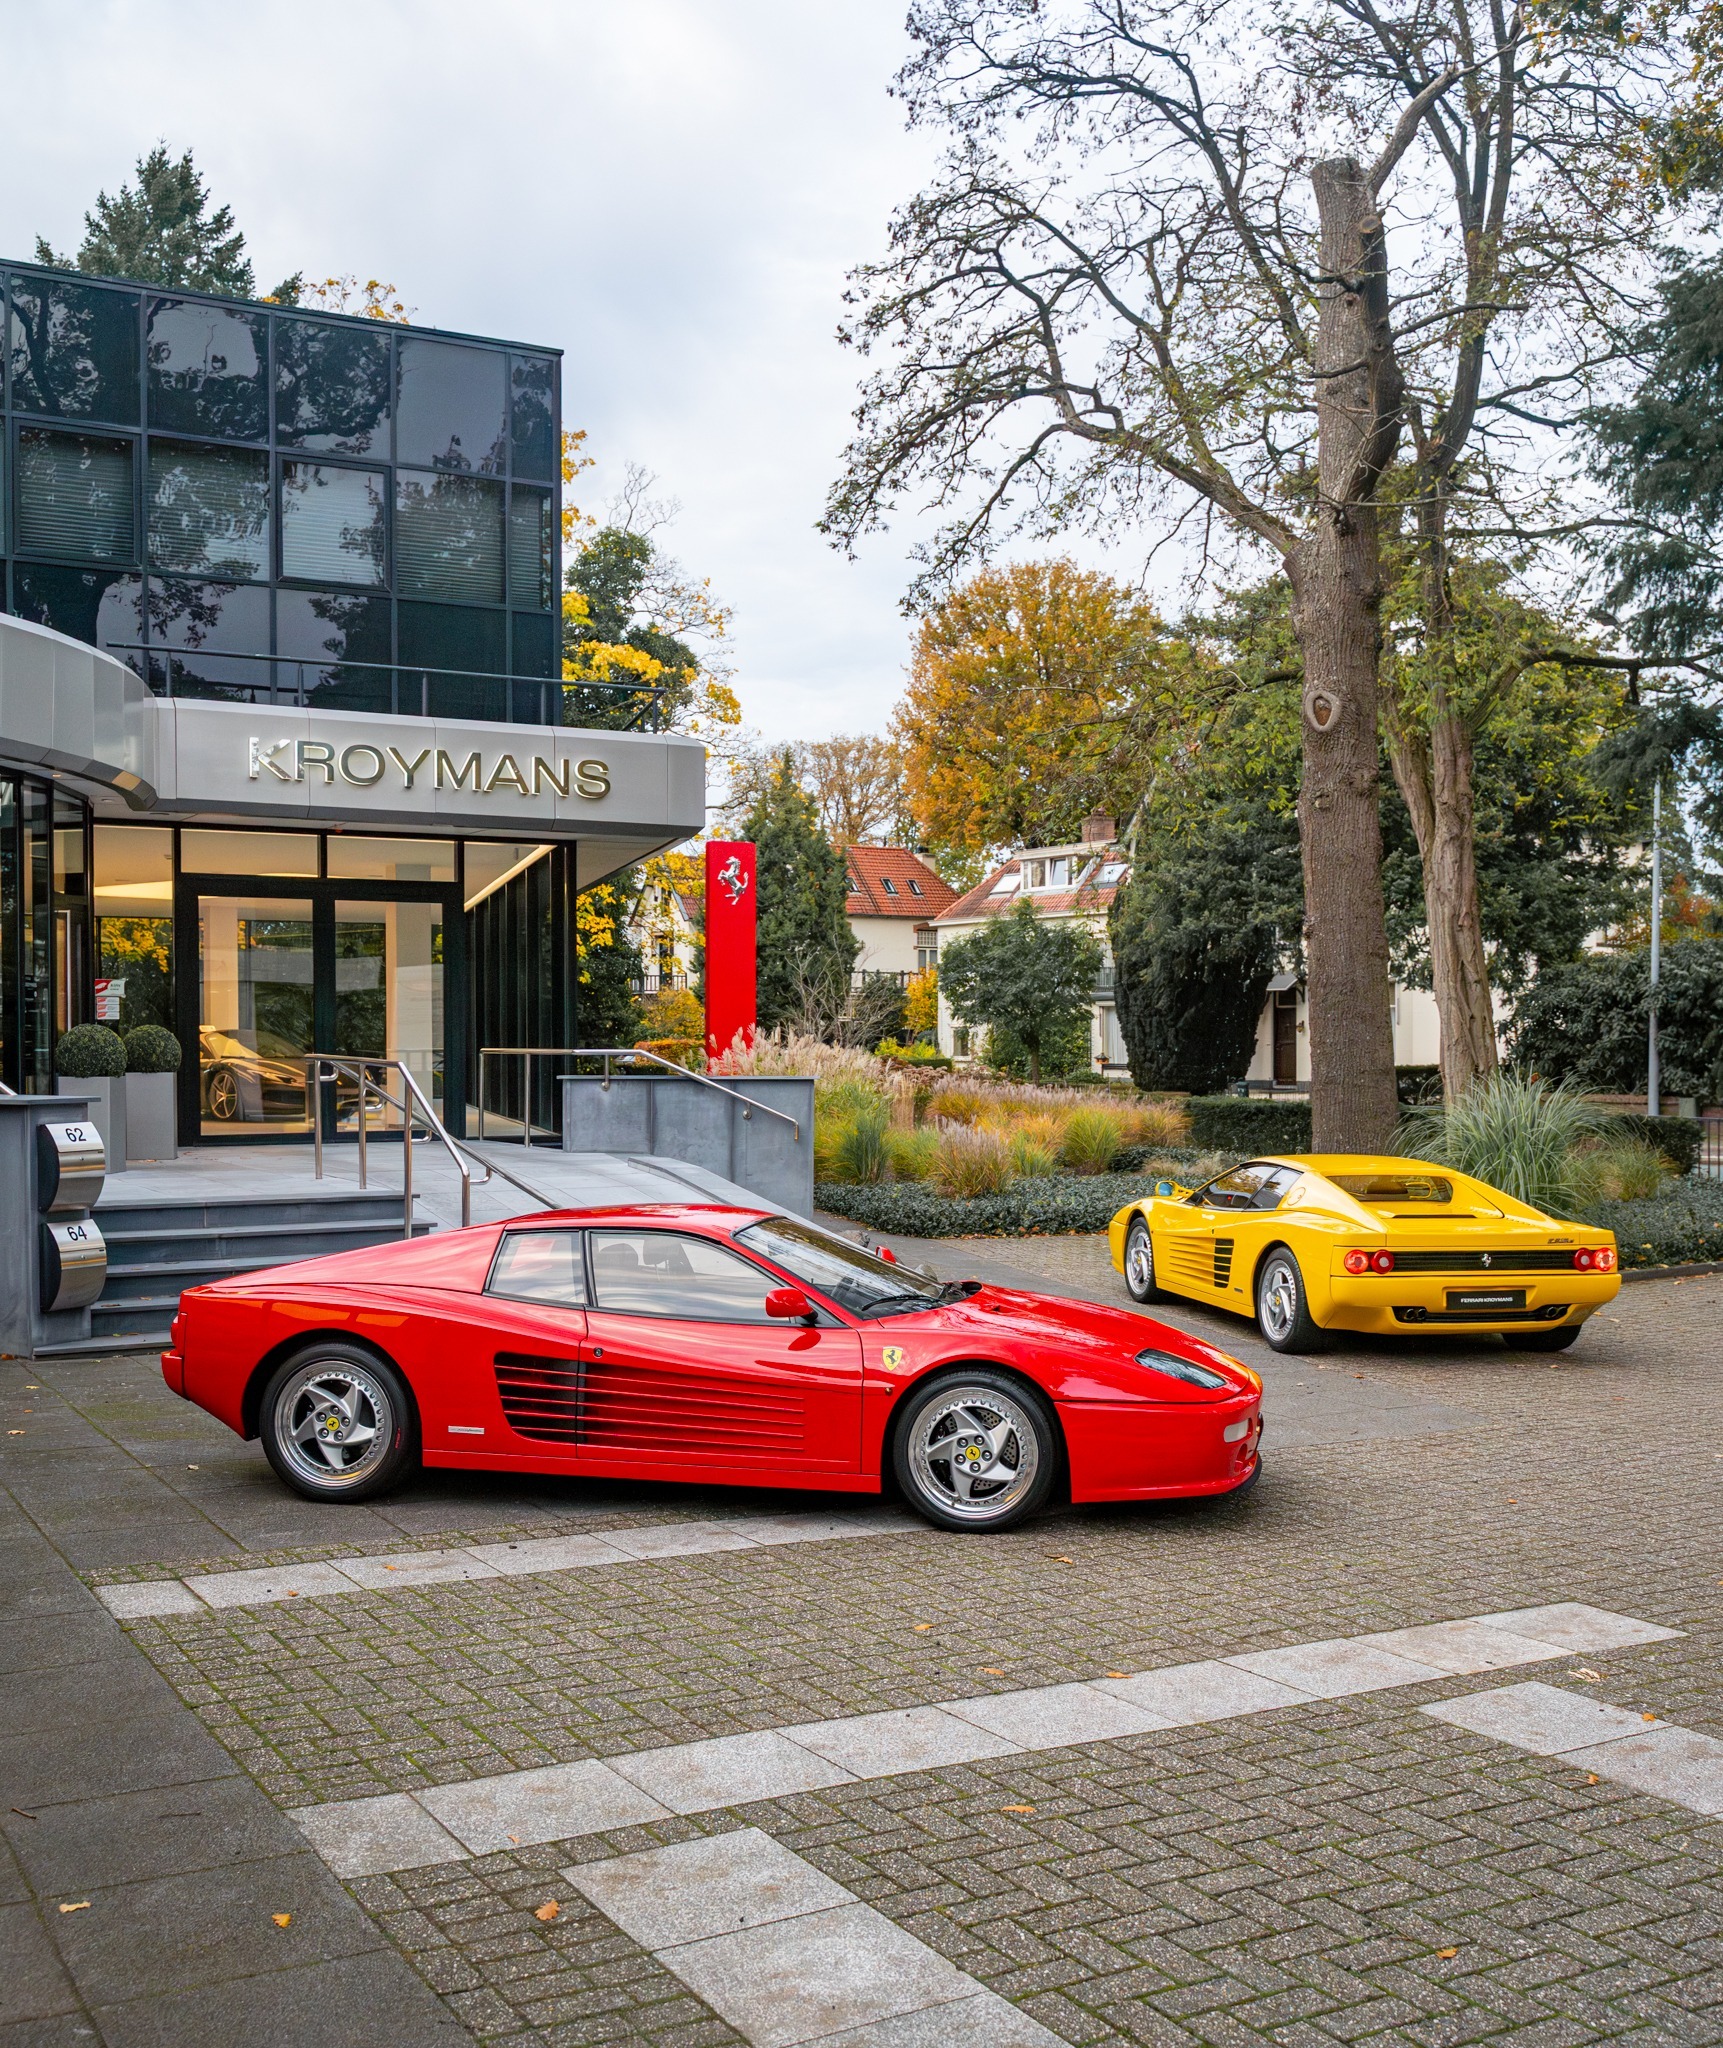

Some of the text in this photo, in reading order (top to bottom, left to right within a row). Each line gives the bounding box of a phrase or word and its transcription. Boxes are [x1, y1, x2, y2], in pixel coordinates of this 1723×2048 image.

[249, 737, 611, 799] KROYMANS
[65, 1128, 87, 1143] 62
[67, 1225, 88, 1241] 64
